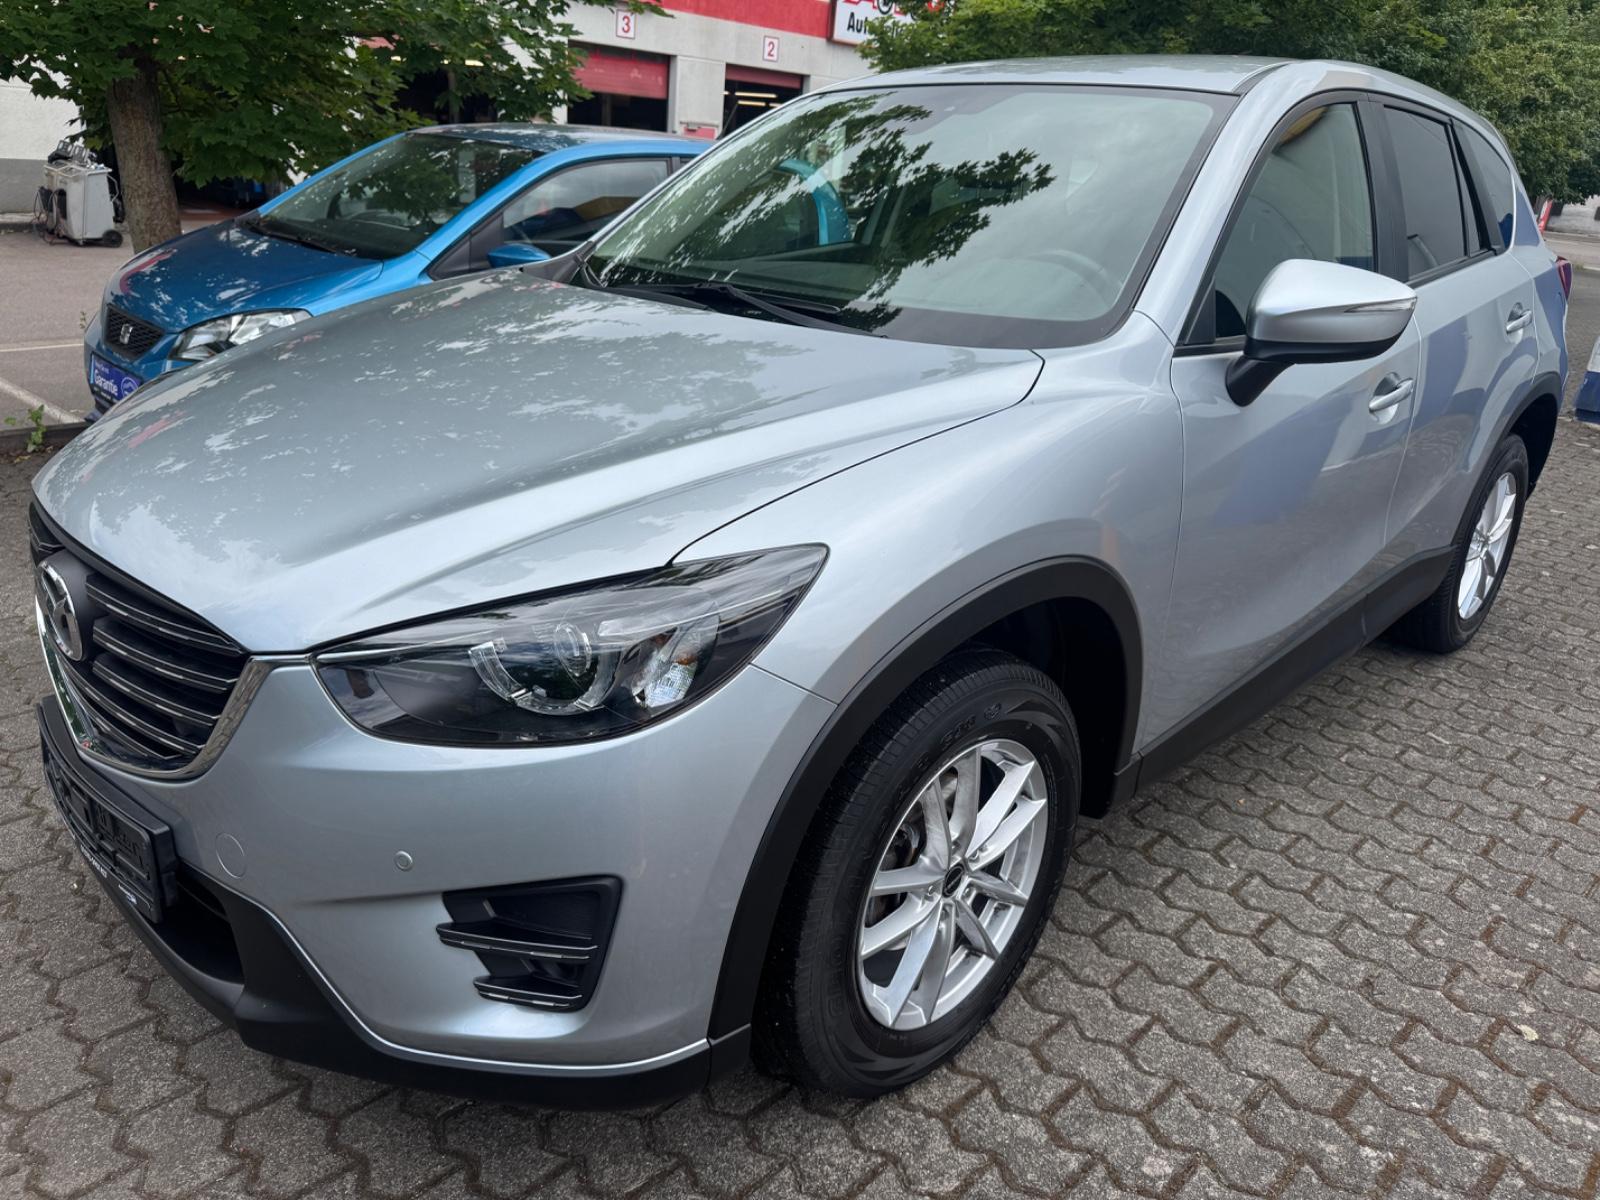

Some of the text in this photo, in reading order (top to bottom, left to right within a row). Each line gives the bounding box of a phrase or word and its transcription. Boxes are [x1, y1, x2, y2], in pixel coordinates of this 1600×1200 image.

[622, 15, 631, 34] 3
[847, 11, 870, 35] Aut
[767, 41, 775, 57] 2
